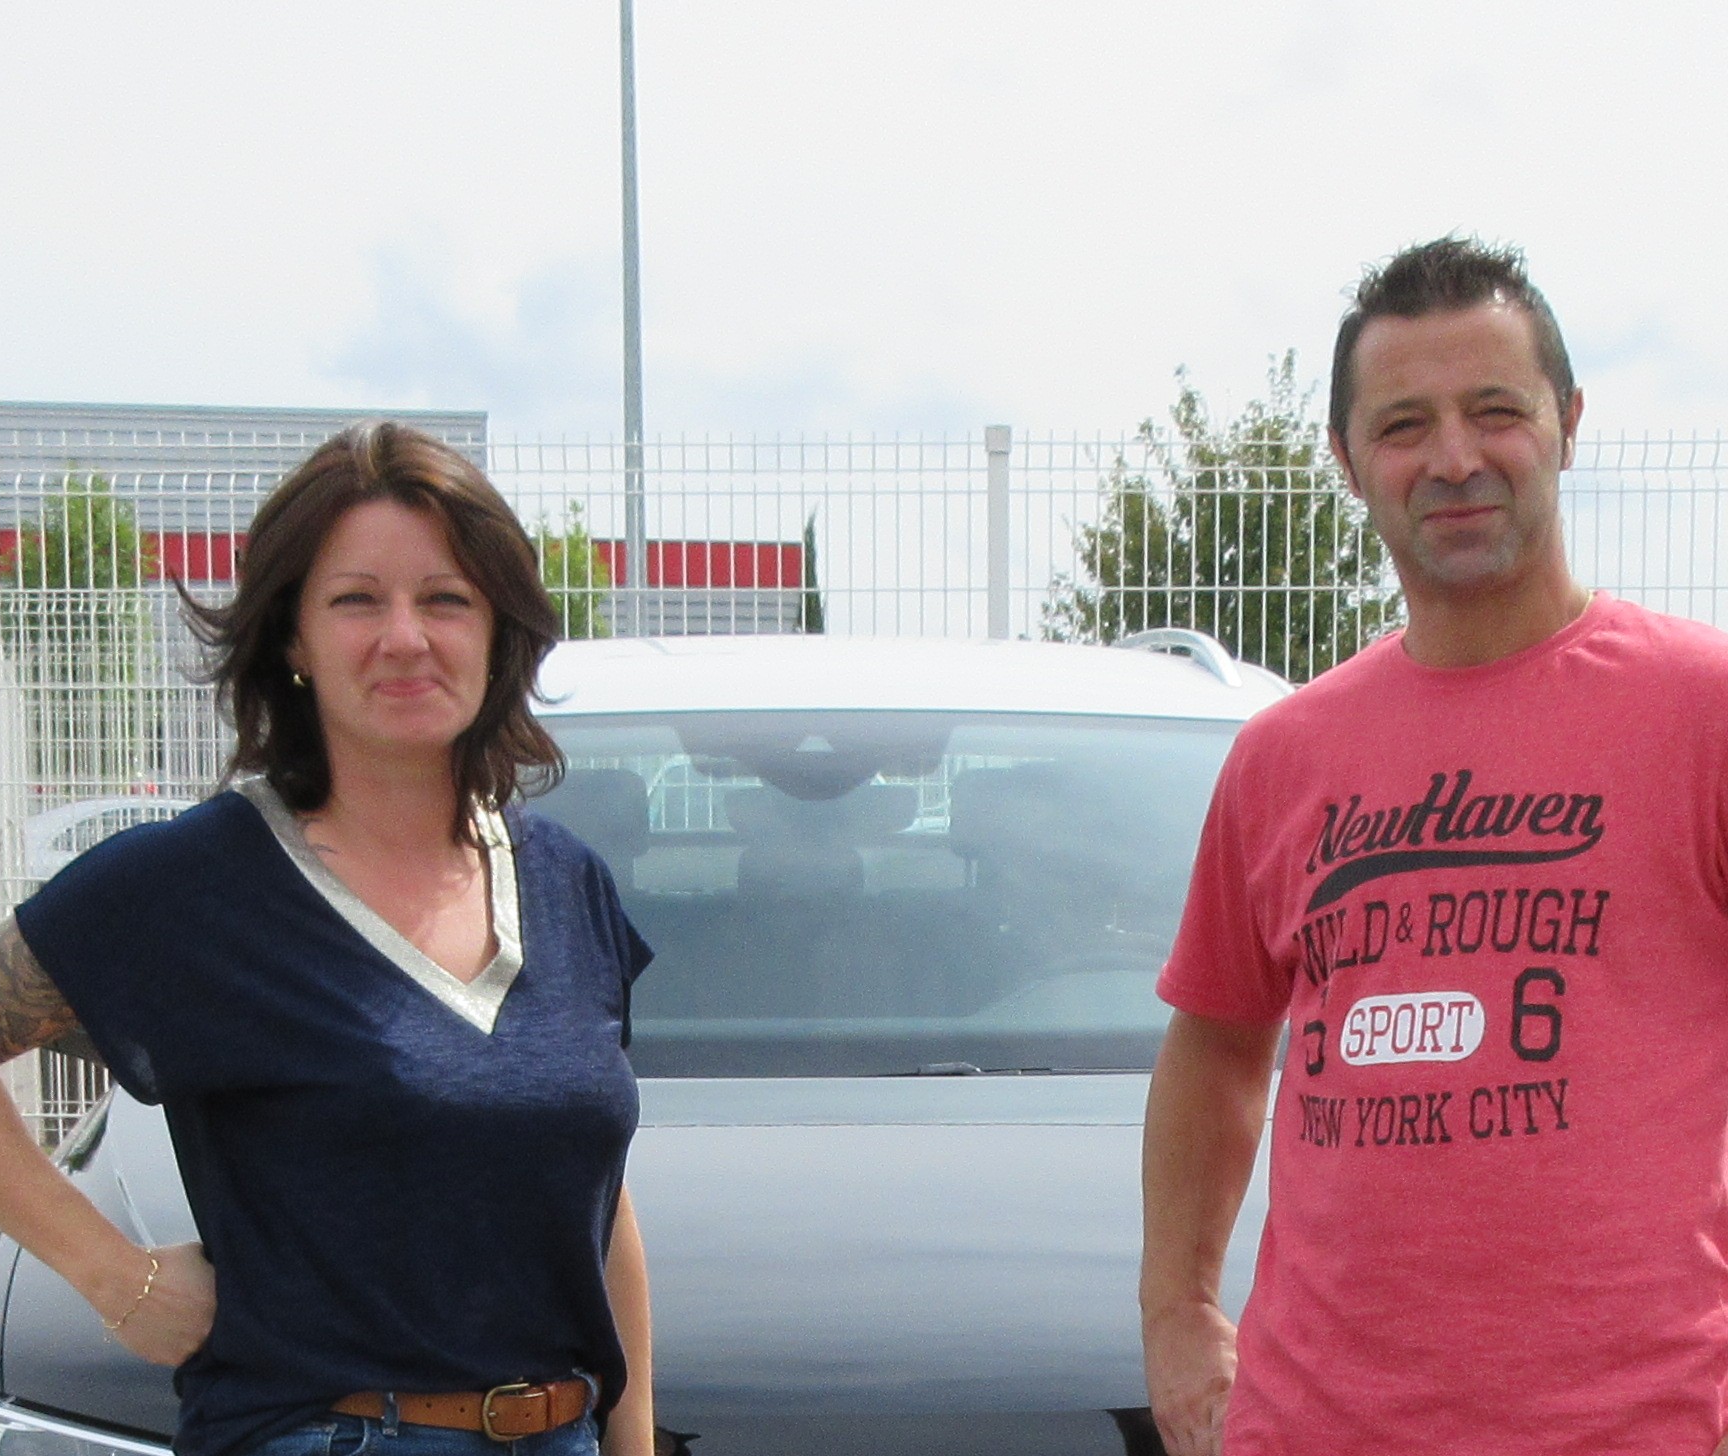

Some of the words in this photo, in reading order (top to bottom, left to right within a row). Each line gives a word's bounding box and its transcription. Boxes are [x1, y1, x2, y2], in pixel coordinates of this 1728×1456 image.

[1422, 888, 1611, 957] ROUGH
[1345, 1001, 1476, 1058] SPORT
[1510, 967, 1566, 1063] 6
[1354, 1091, 1453, 1147] YORK
[1469, 1078, 1570, 1139] CITY
